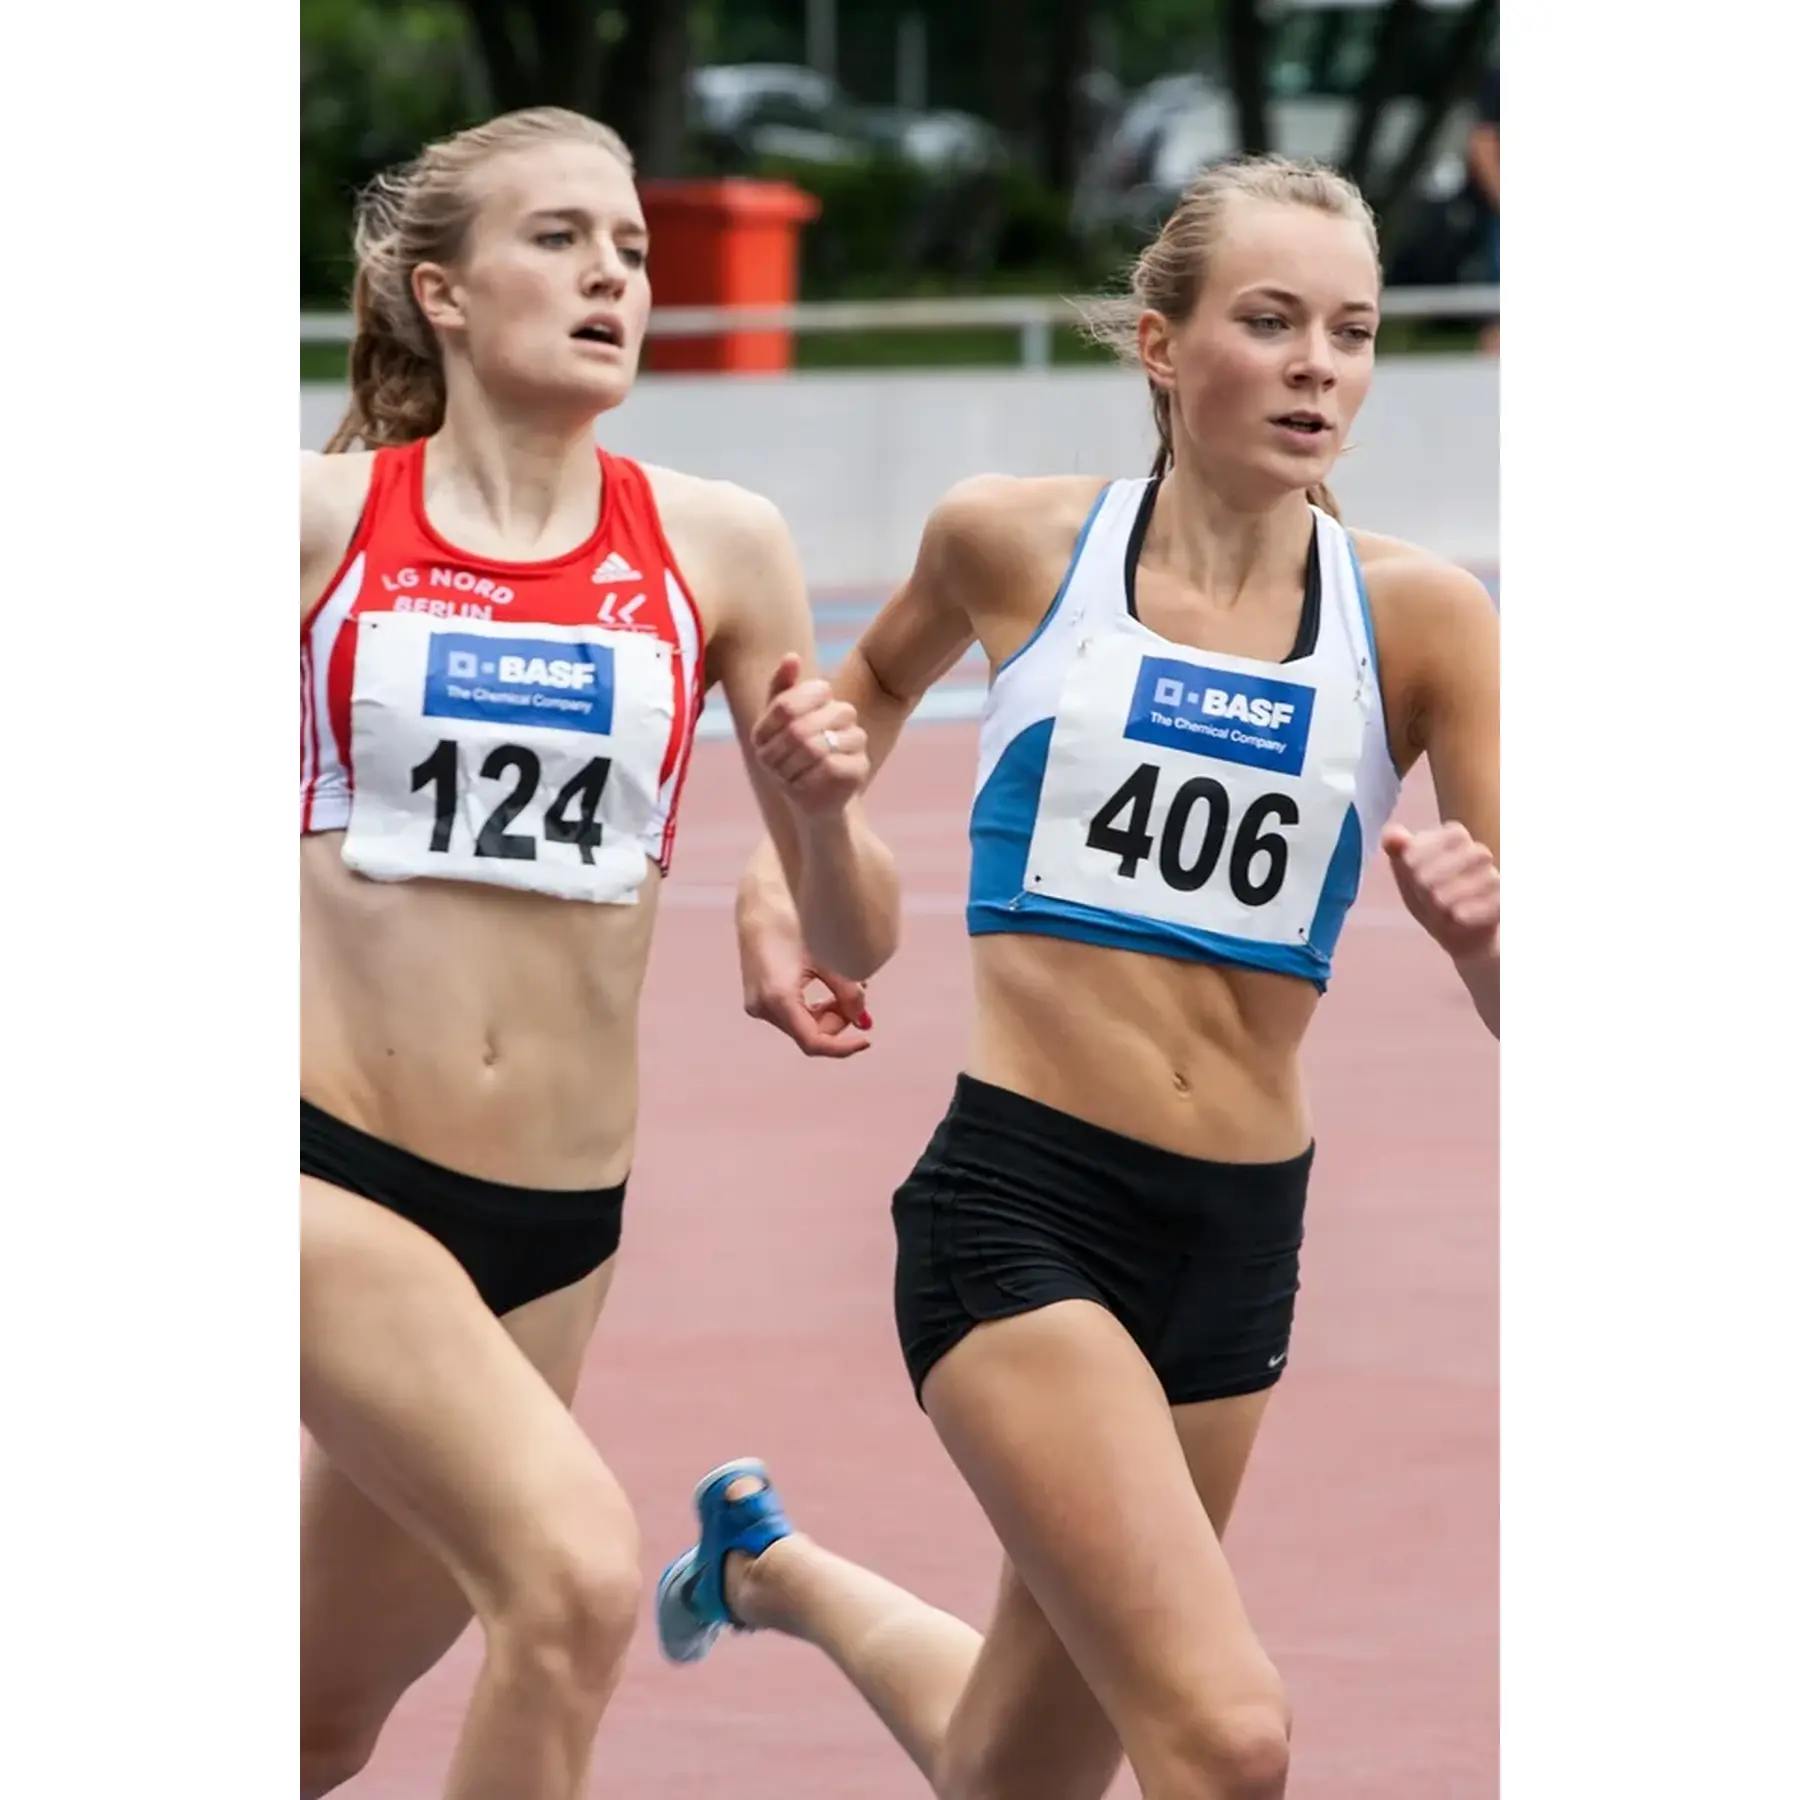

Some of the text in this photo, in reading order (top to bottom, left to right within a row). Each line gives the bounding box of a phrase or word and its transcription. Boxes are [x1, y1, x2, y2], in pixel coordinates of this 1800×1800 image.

[430, 567, 515, 605] NORD
[499, 655, 596, 690] BASF
[446, 684, 593, 715] The Chemical Company
[1201, 688, 1295, 731] BASF
[1150, 711, 1287, 755] The Chemical Company
[410, 739, 613, 865] 124
[1085, 762, 1299, 907] 406
